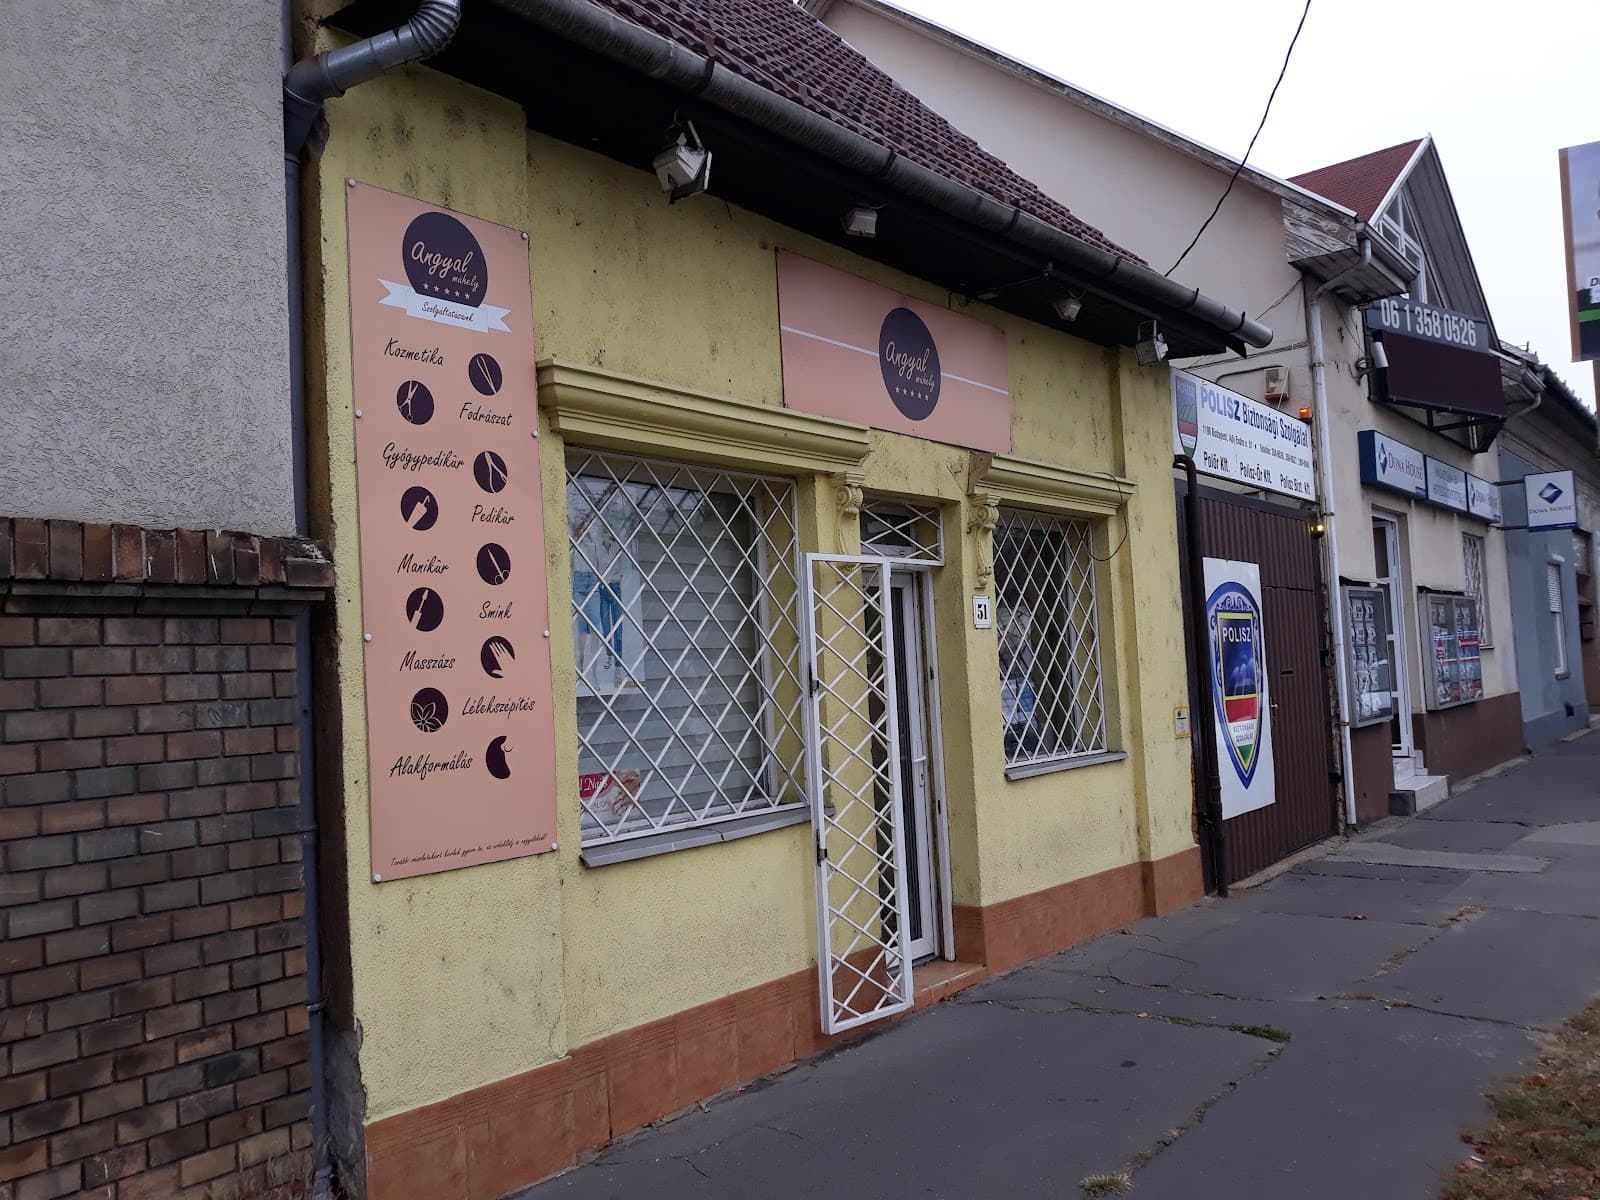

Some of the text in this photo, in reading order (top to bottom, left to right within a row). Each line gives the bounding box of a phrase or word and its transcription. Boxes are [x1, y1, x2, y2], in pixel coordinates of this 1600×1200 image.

[411, 241, 474, 279] Angyal
[1380, 299, 1477, 347] 06 1 358 0526
[383, 337, 444, 367] Kozmetika
[885, 341, 930, 380] Angyal
[459, 402, 513, 426] Fodrászat
[1200, 386, 1309, 449] POLISZ Biztonsági Szolgálat
[479, 600, 513, 619] Smink
[976, 603, 988, 620] 51
[1222, 627, 1252, 643] POLISZ
[400, 650, 456, 671] Masszázs
[462, 695, 536, 719] Lélekszépítés
[390, 750, 473, 781] Alakformálás
